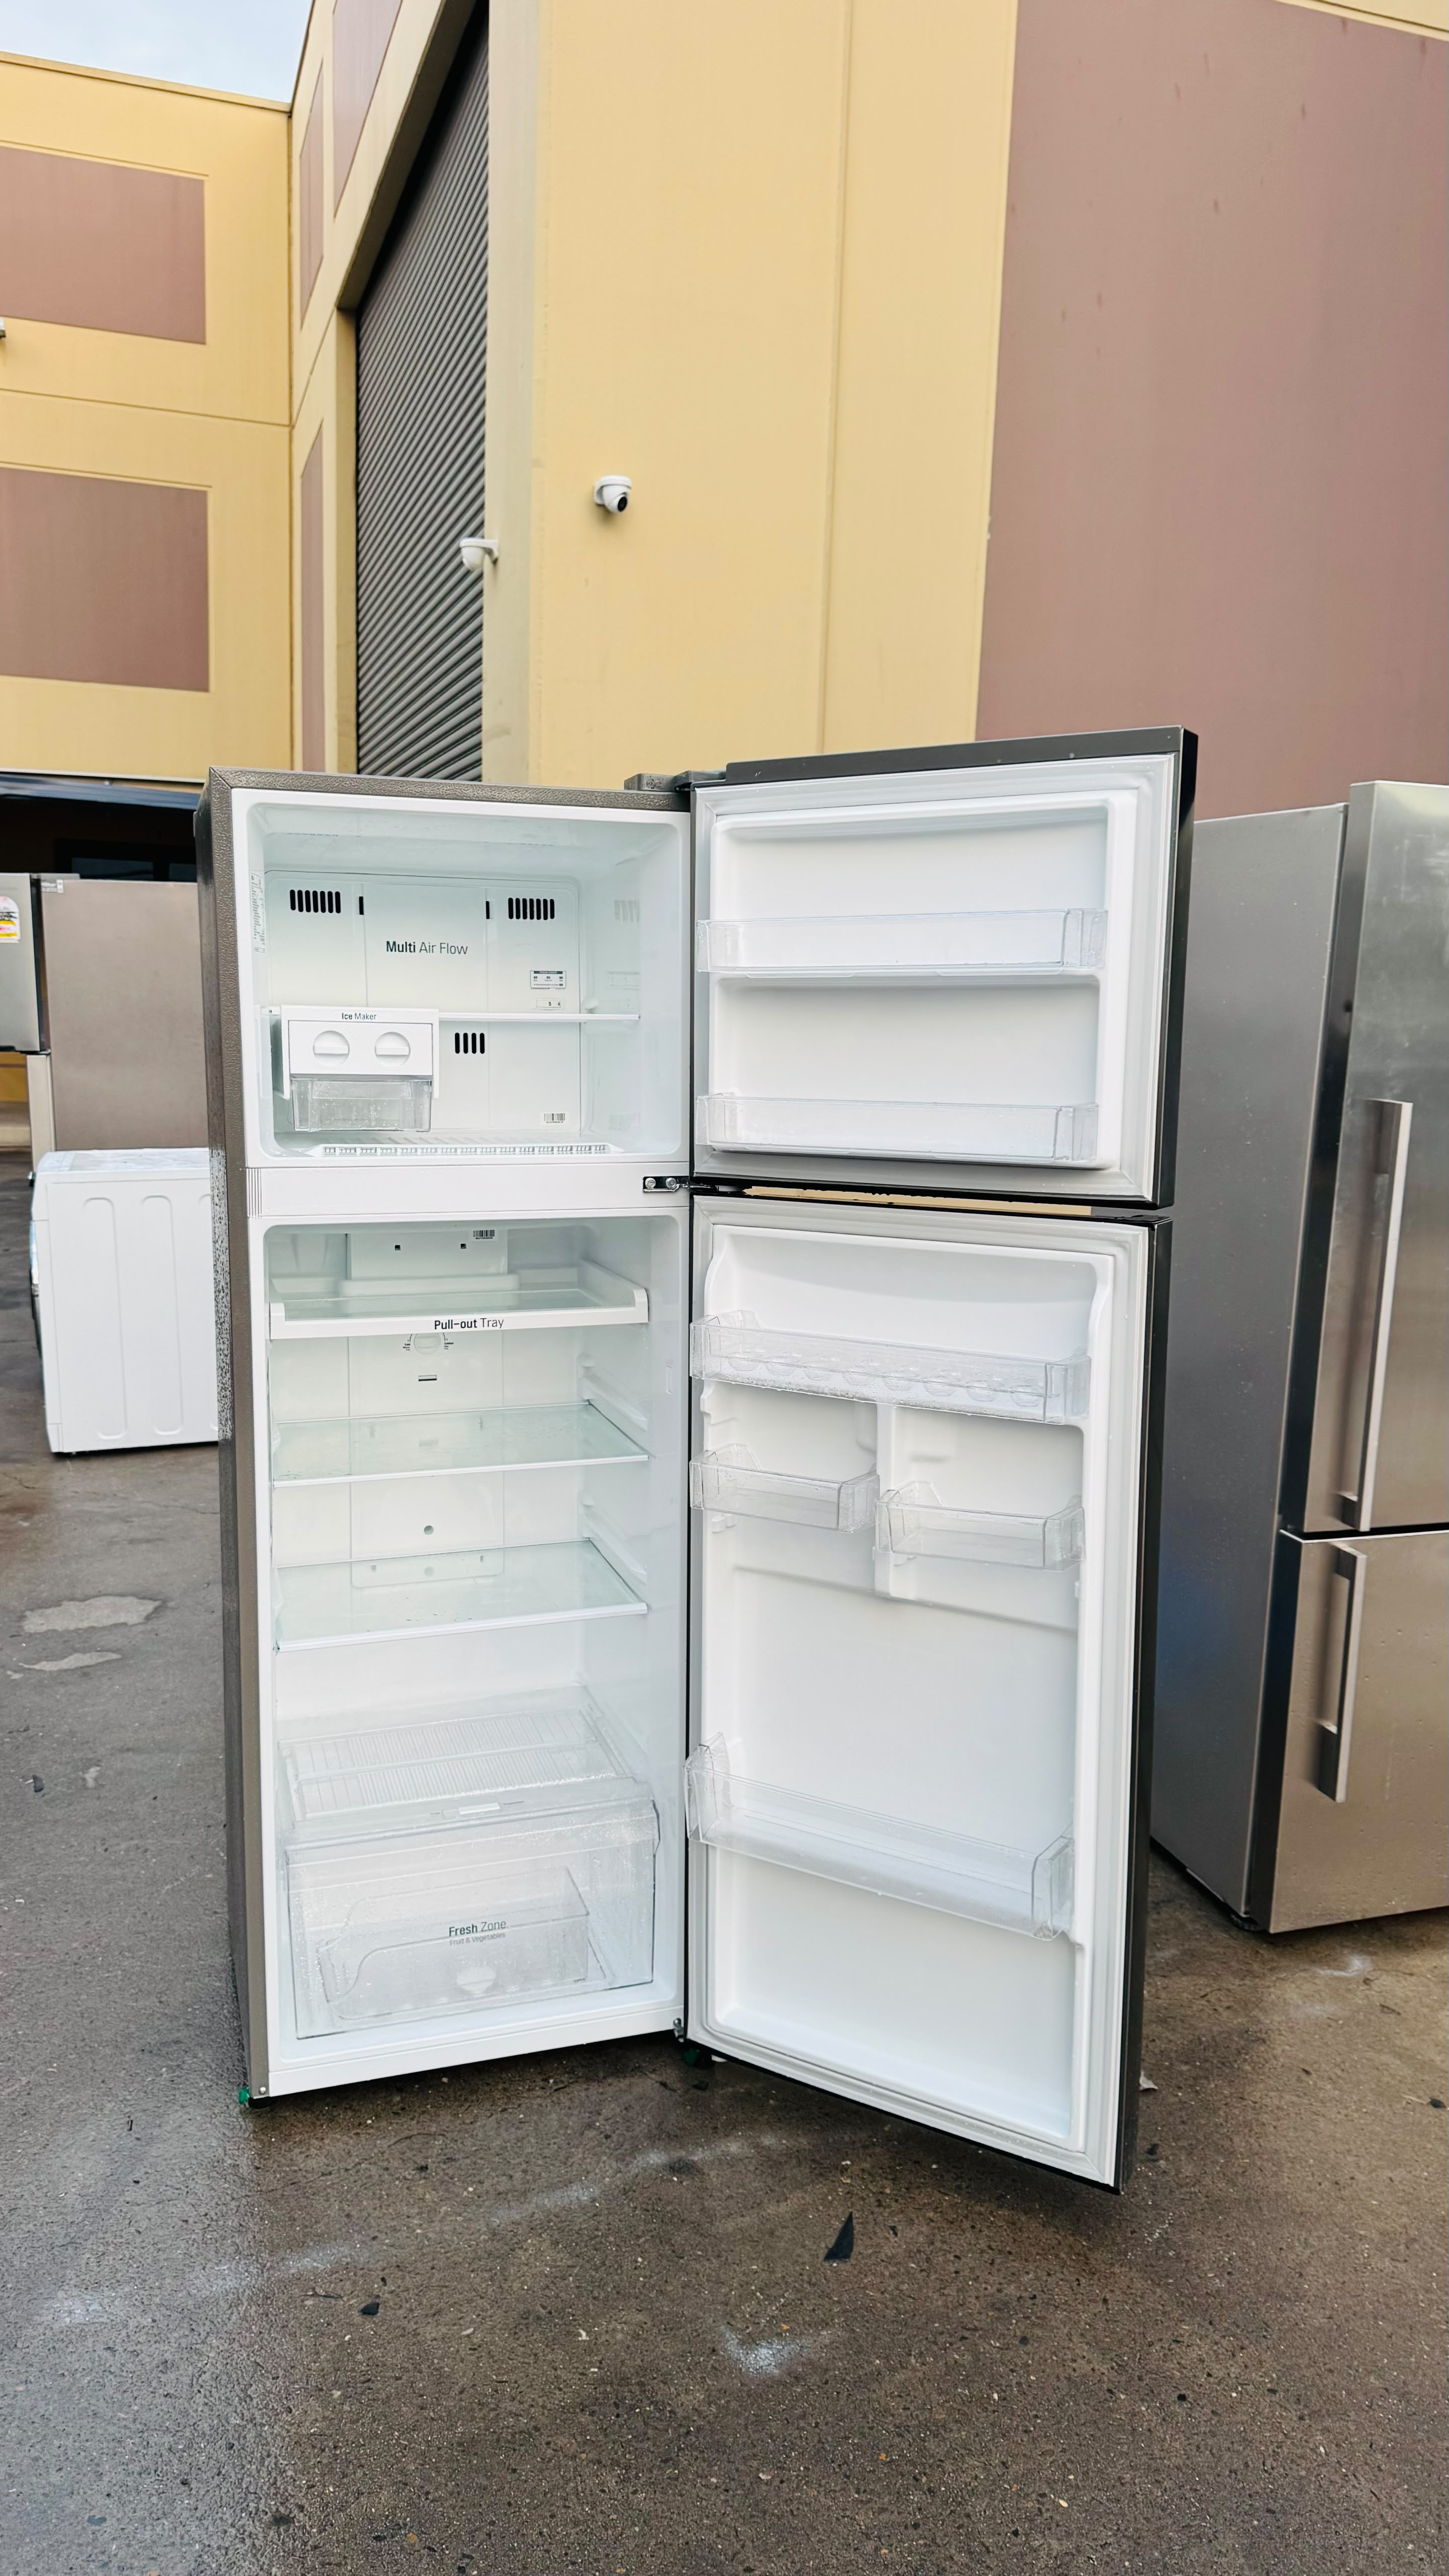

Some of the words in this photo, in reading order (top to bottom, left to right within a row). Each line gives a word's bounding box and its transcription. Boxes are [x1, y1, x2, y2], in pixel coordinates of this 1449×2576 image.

[386, 940, 416, 953] Multi
[419, 942, 437, 954] Air
[439, 942, 468, 955] Flow
[354, 1012, 377, 1020] Maker
[434, 1319, 477, 1330] Pull-out
[480, 1318, 504, 1329] Tray
[449, 1923, 478, 1937] Fresh
[480, 1920, 507, 1932] Zone
[449, 1938, 464, 1946] Fruit
[471, 1932, 506, 1943] Vegetables
